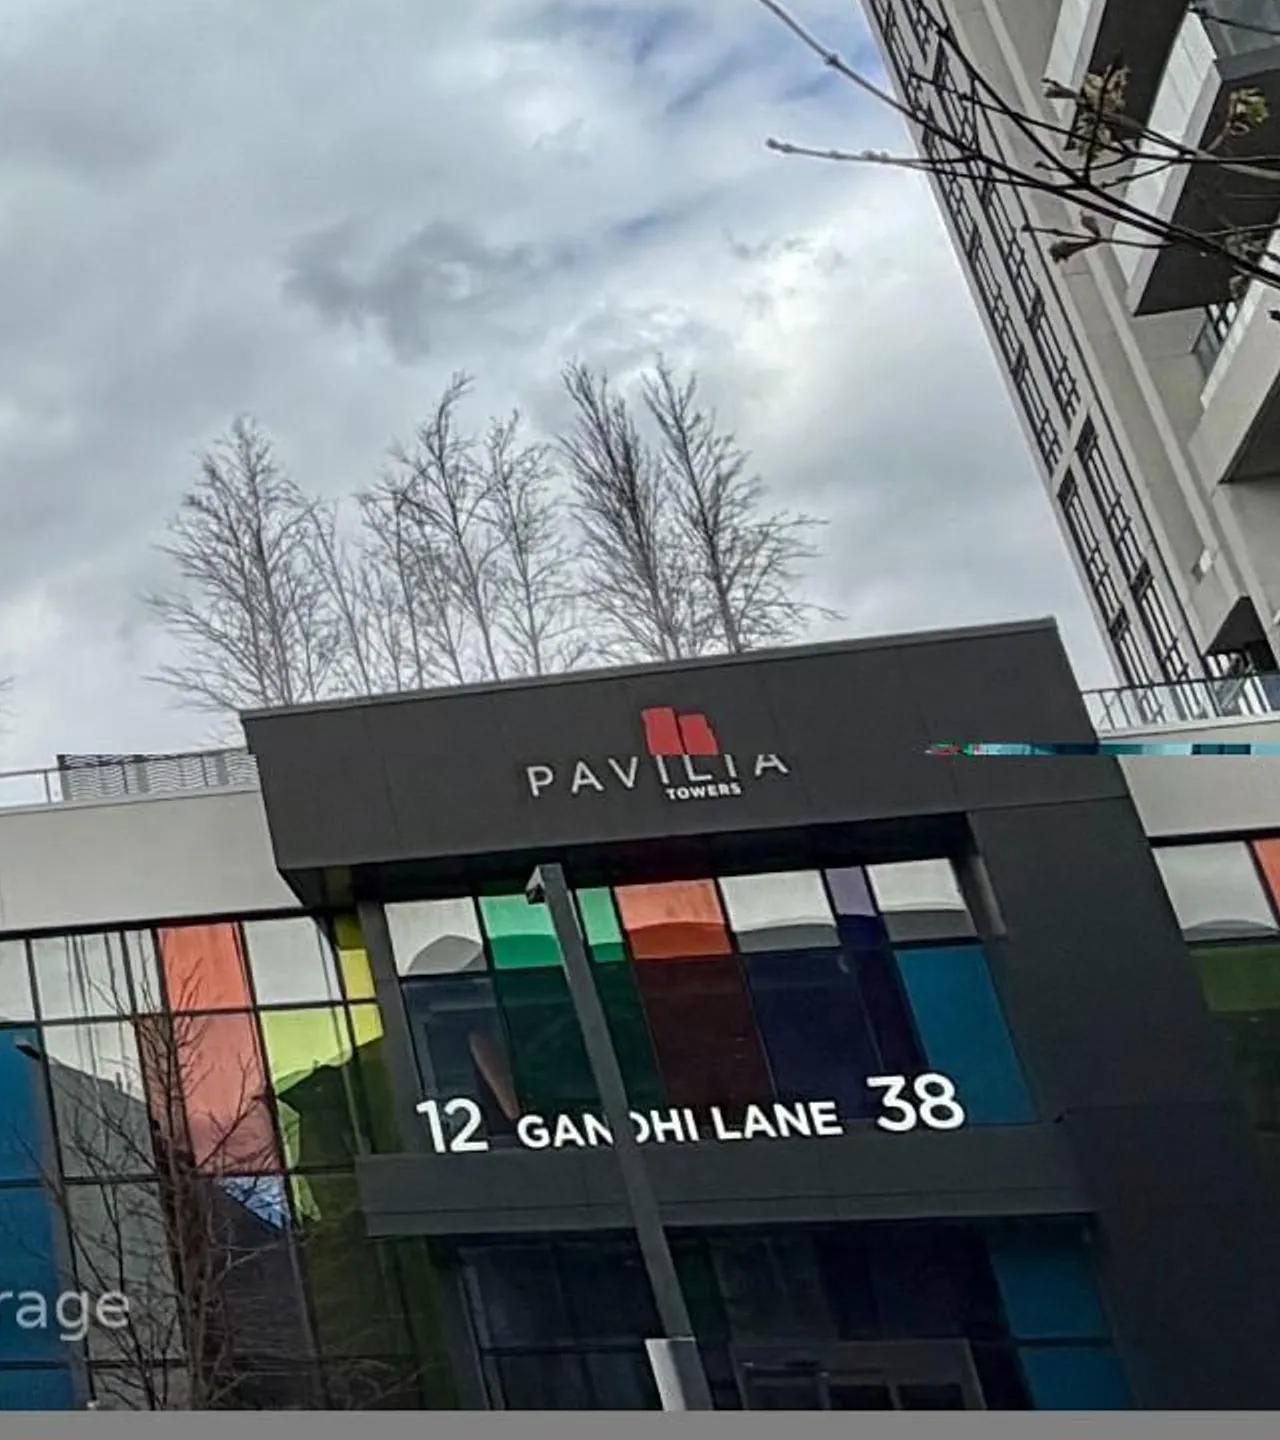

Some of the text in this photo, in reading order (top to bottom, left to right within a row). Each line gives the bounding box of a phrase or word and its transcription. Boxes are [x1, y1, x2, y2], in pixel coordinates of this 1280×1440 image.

[526, 754, 790, 798] PAVILIA
[665, 782, 742, 801] TOWERS
[416, 1097, 489, 1153] 12
[710, 1101, 844, 1141] LANE
[866, 1072, 966, 1133] 38
